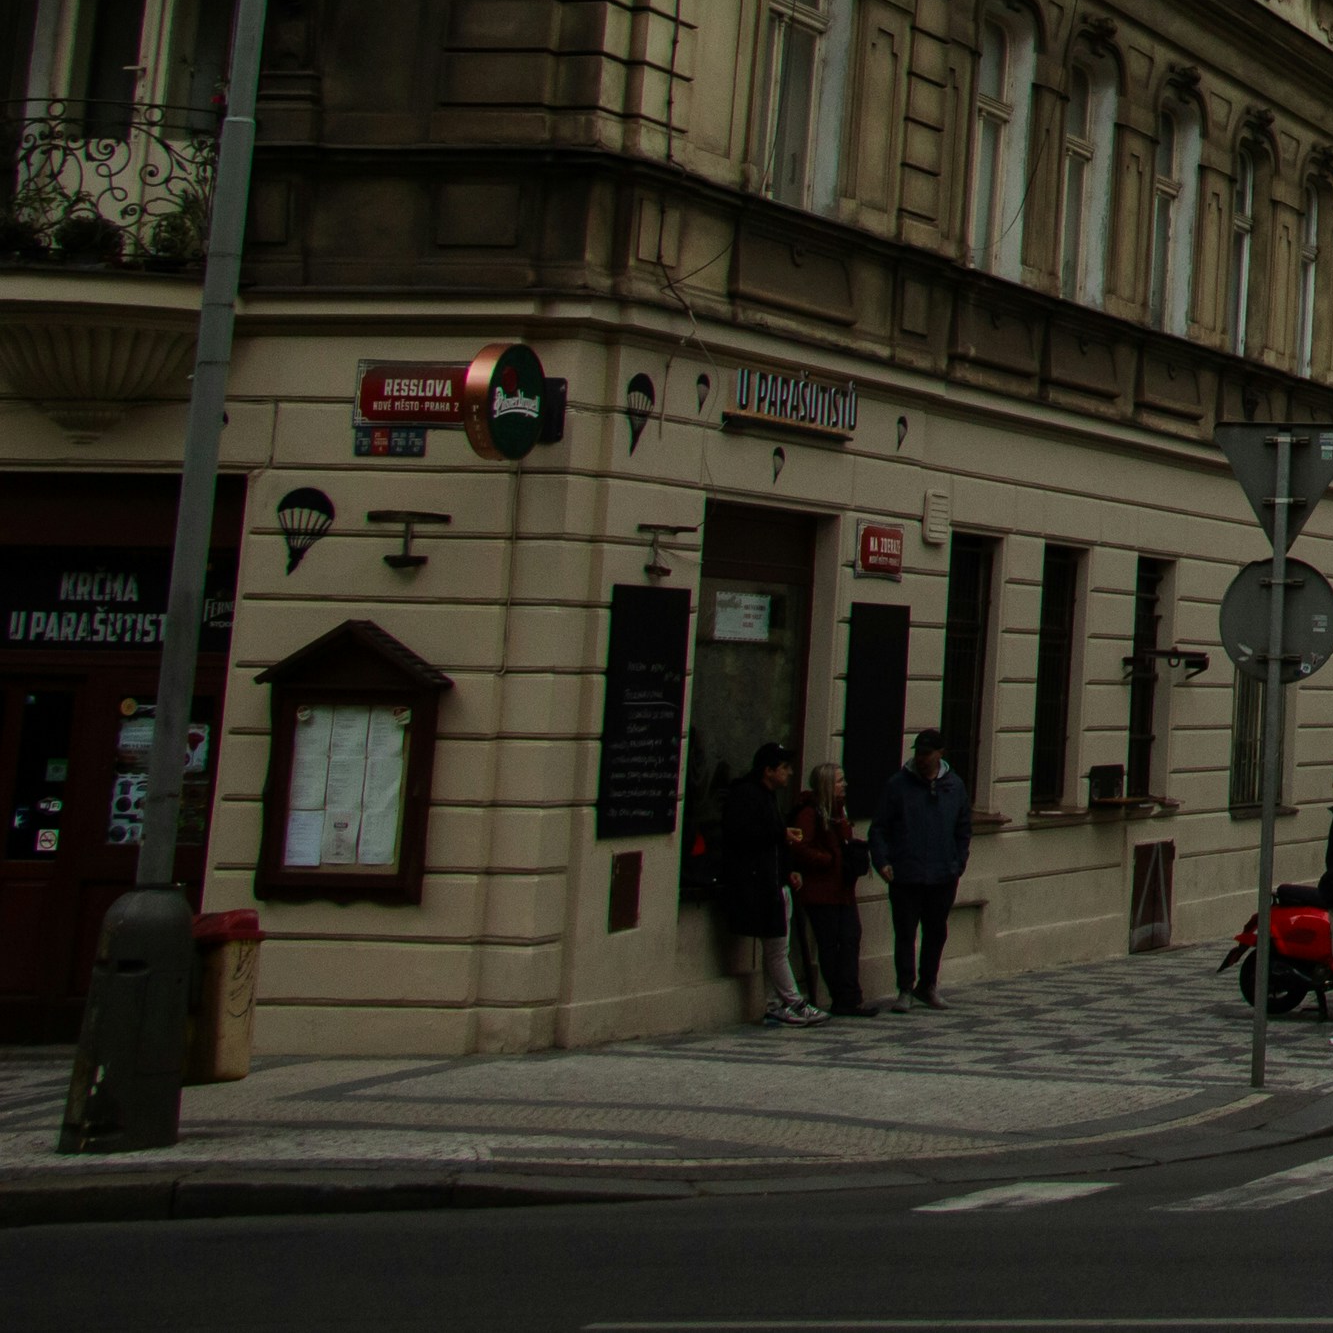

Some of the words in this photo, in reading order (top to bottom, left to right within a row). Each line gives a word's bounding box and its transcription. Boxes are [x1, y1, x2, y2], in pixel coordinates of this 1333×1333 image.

[384, 379, 452, 397] RESSLOVA
[737, 368, 749, 409] U
[754, 370, 857, 430] PARAŠUTISTŮ
[373, 399, 392, 411] NOVÉ
[454, 402, 459, 412] 2
[870, 536, 878, 552] NA
[59, 566, 139, 602] KRČMA
[203, 597, 233, 622] FERN
[8, 611, 27, 641] U
[29, 606, 168, 643] PARAŠUTIST
